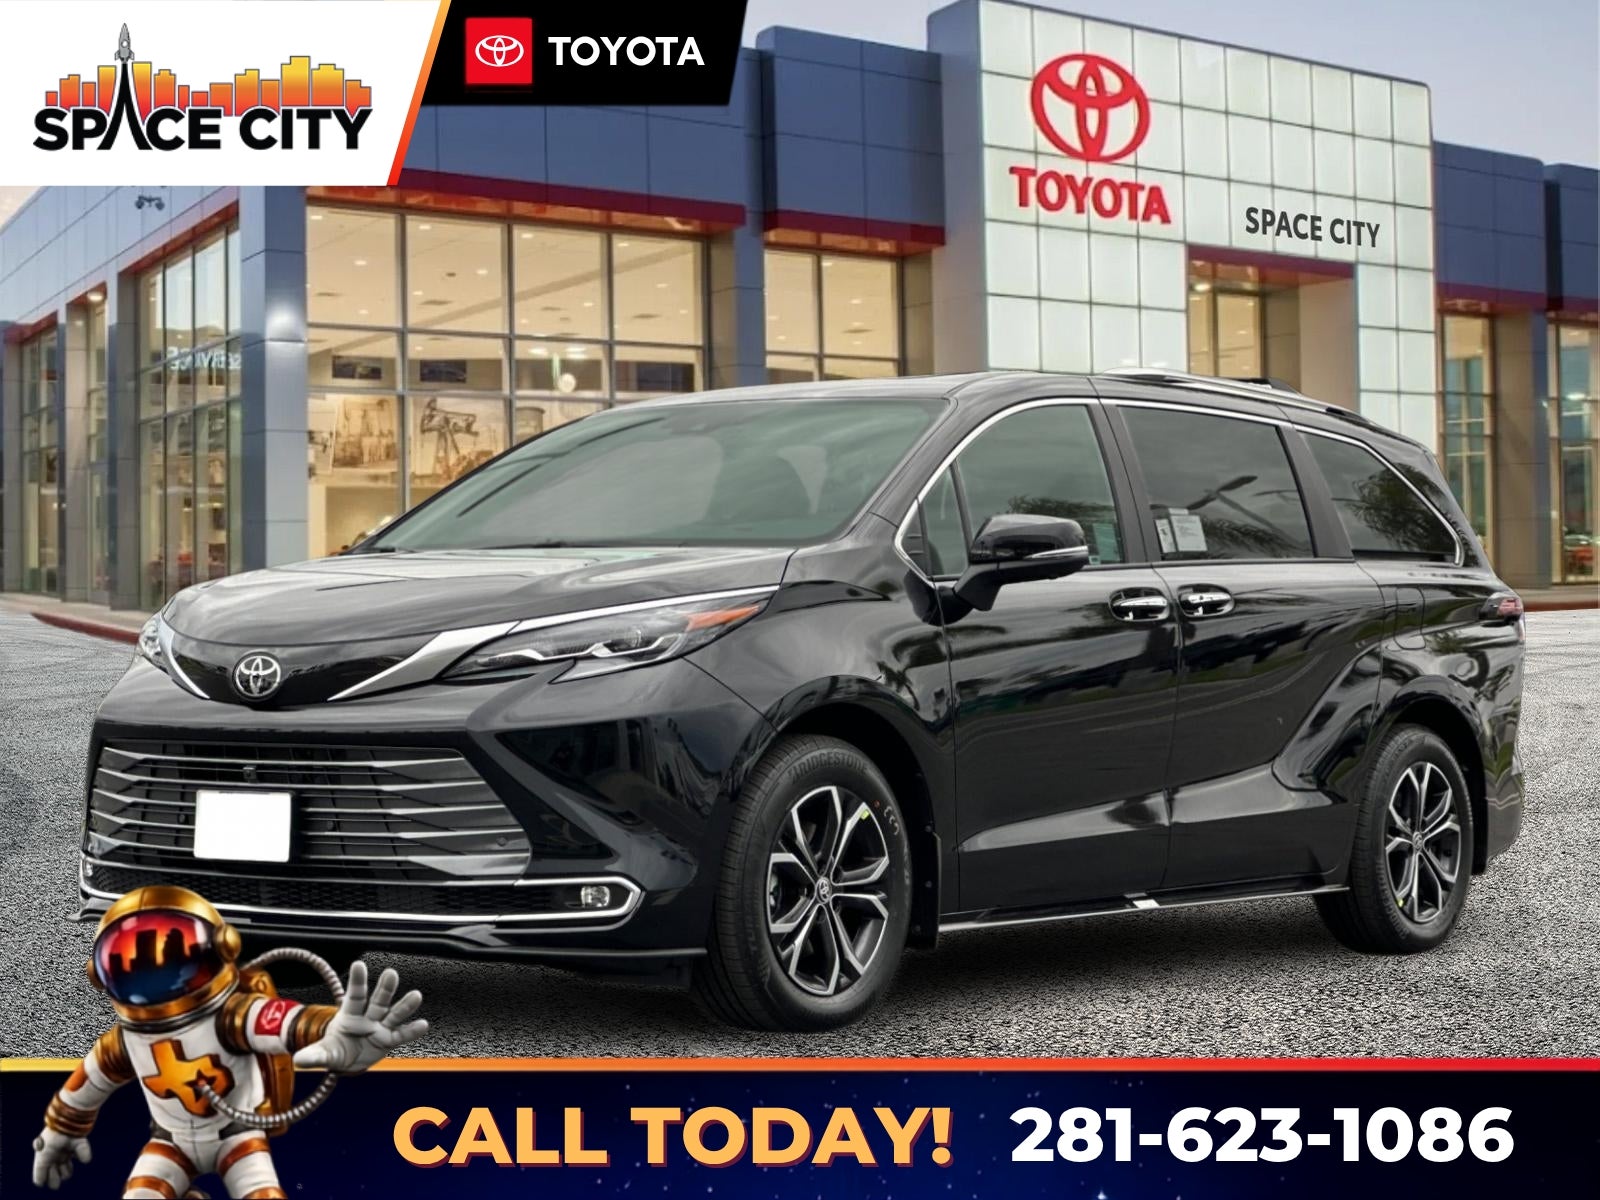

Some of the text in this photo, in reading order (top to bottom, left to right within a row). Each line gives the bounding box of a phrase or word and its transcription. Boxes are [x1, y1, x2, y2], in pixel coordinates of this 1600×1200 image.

[1009, 166, 1171, 224] TOYOTA
[1245, 206, 1381, 248] SPACE CITY
